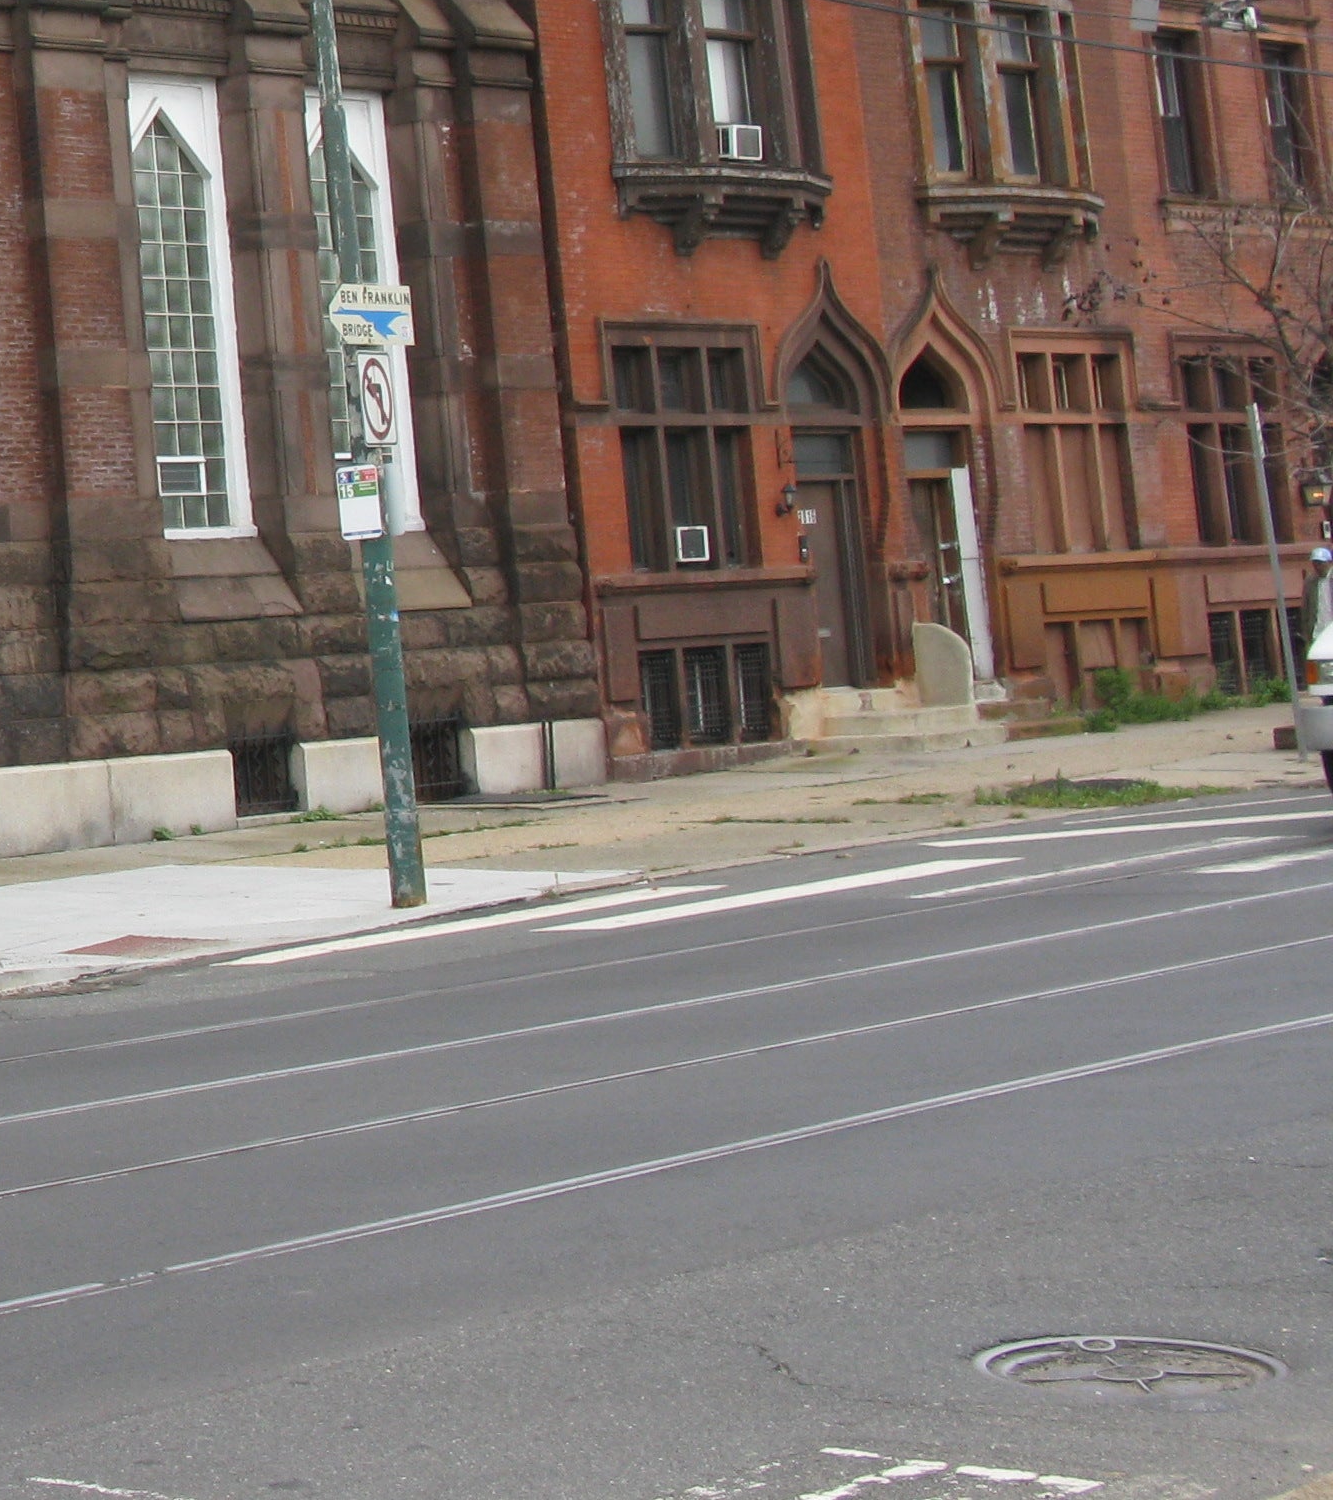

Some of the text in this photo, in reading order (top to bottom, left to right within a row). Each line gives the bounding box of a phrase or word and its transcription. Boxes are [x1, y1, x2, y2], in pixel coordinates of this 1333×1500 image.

[339, 289, 411, 306] BEN FRANKLIN
[341, 322, 374, 338] BRIDGE
[339, 484, 355, 499] 15
